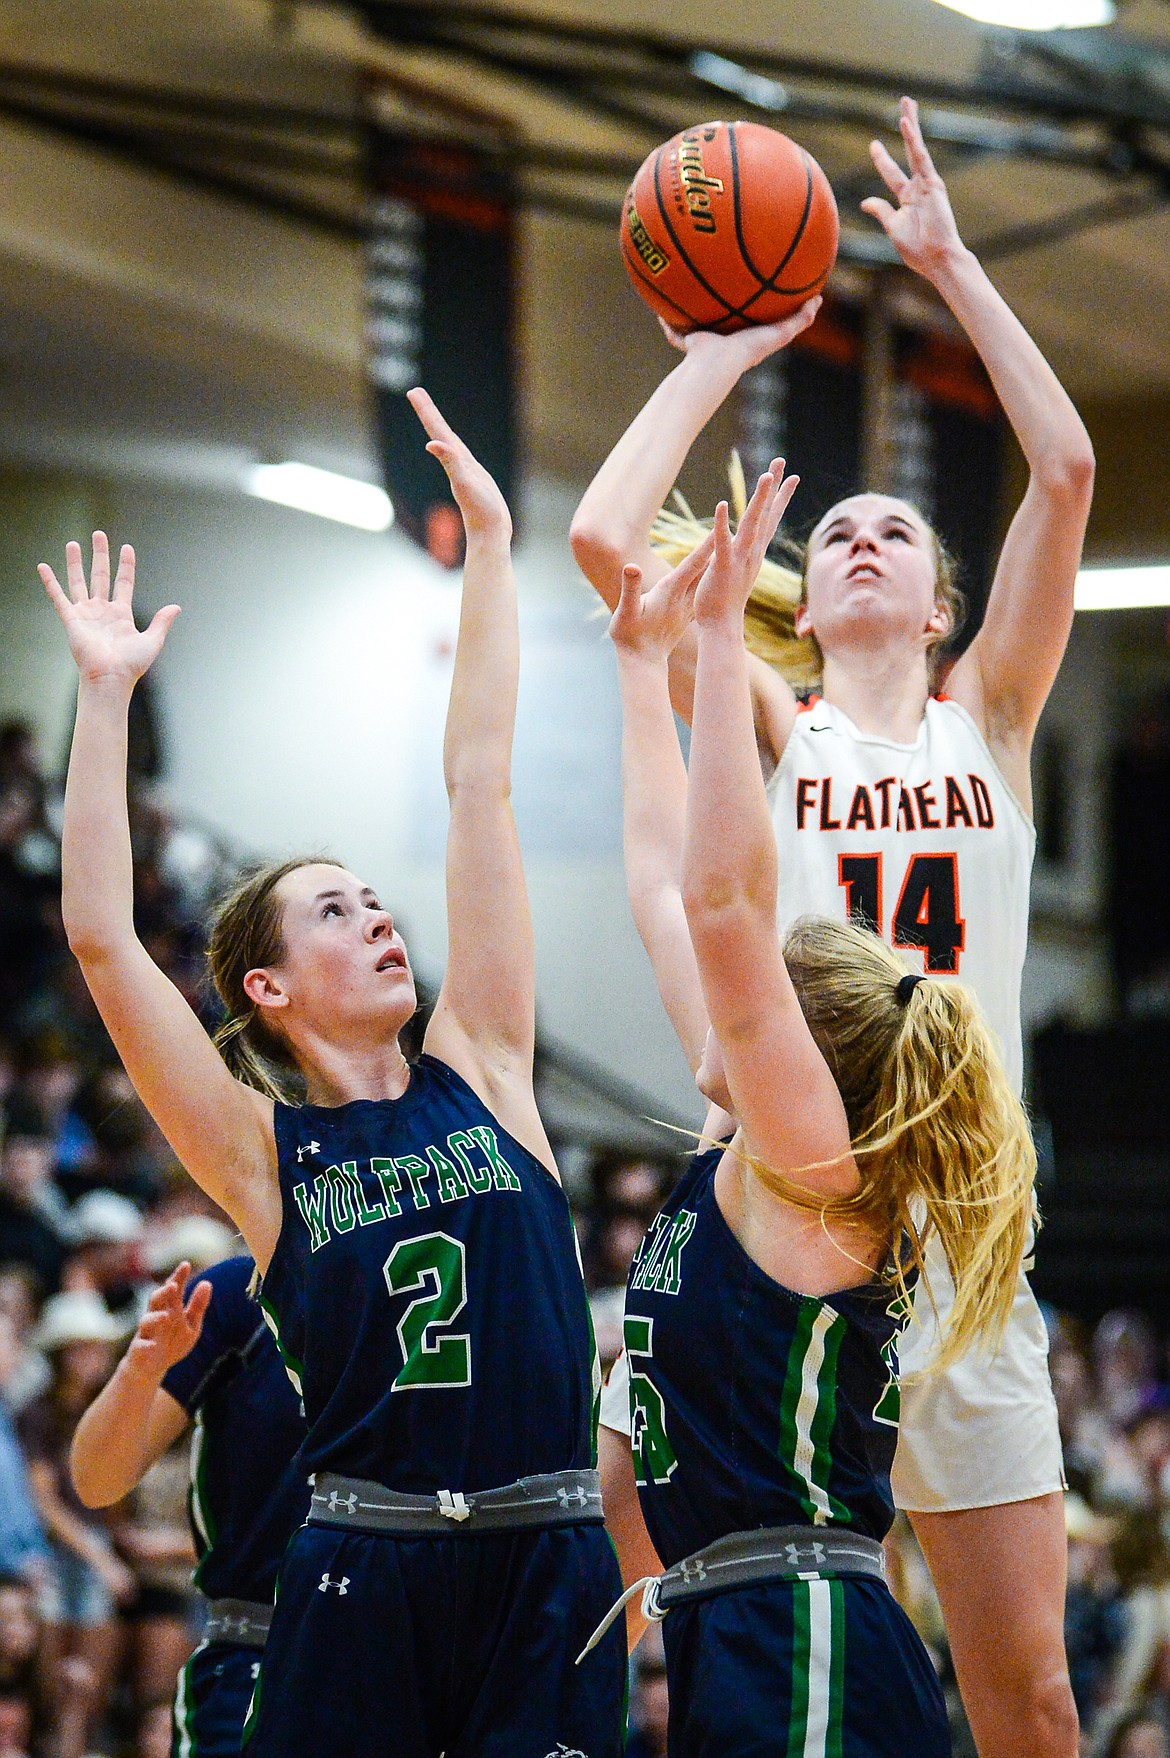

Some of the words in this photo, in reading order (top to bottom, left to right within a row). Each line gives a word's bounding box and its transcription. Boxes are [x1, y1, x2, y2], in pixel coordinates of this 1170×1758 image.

[632, 227, 664, 271] PRO
[796, 773, 995, 833] FLATHEAD
[837, 852, 966, 975] 14
[293, 1126, 522, 1253] WOLFPACK
[382, 1231, 472, 1393] 2
